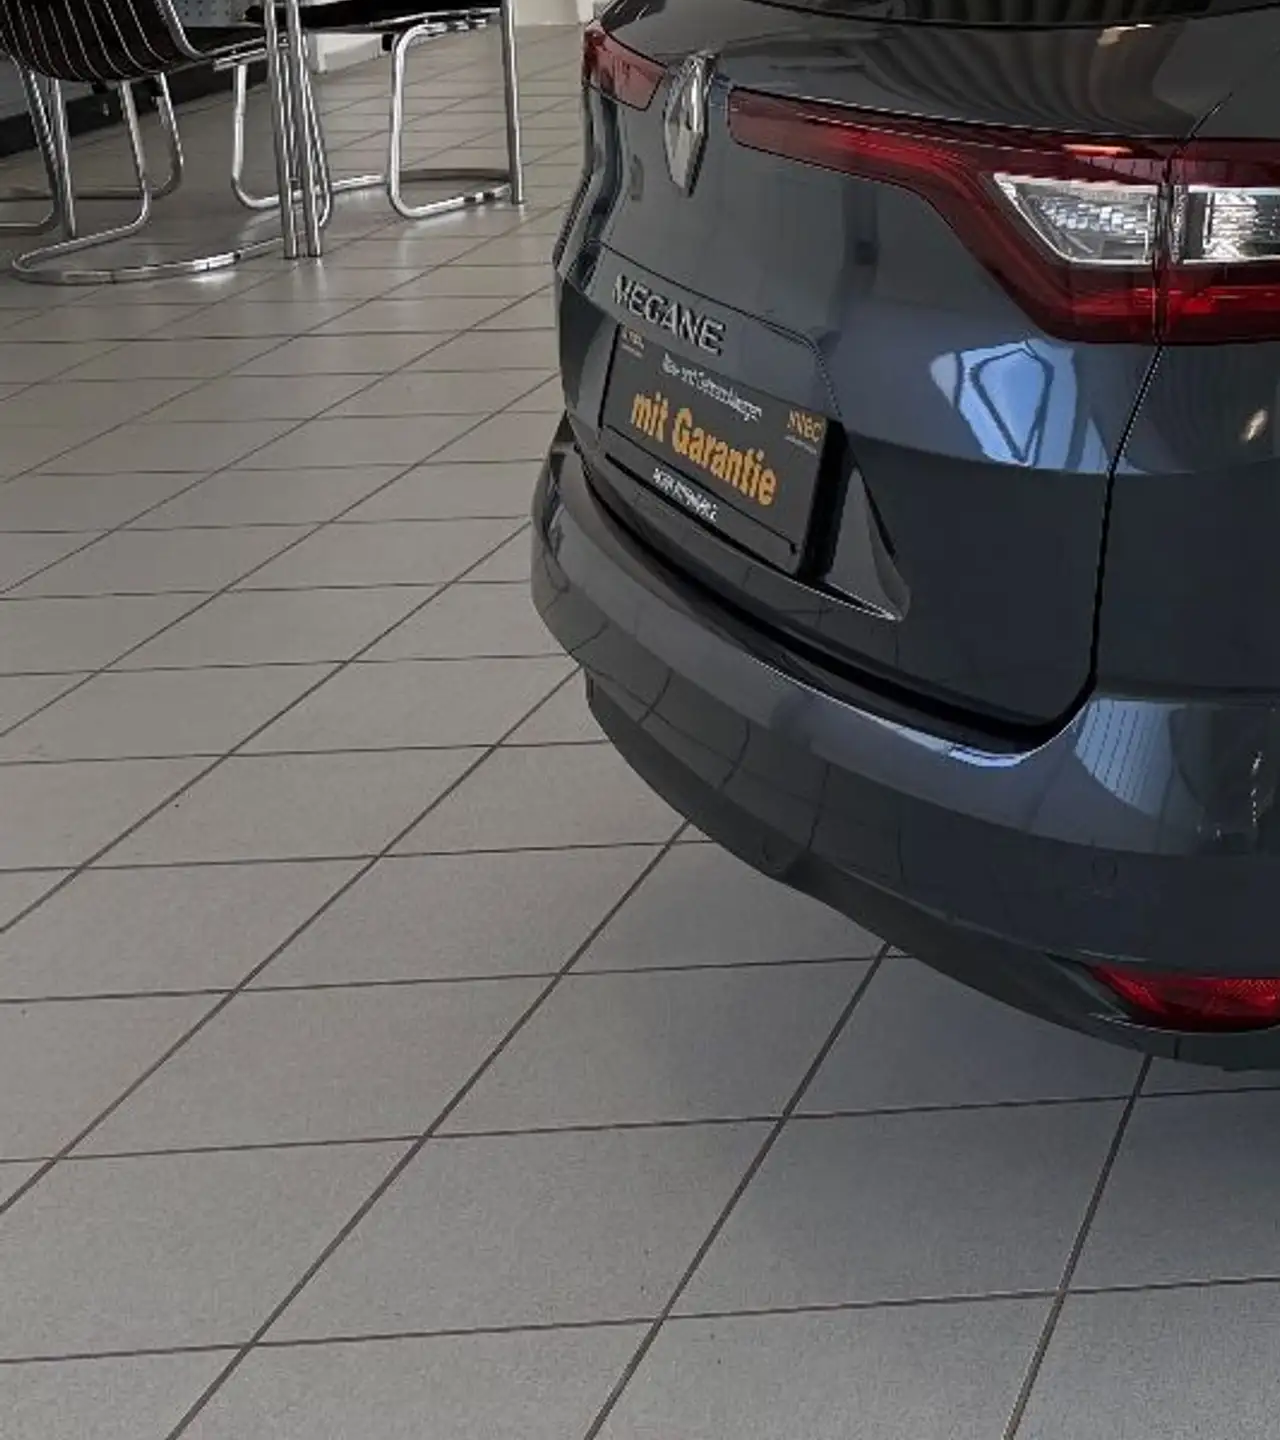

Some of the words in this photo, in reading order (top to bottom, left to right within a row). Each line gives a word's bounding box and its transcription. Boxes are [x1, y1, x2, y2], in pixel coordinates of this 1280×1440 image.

[612, 273, 726, 356] MEGANE
[630, 391, 669, 443] mit
[672, 407, 778, 506] Garantie
